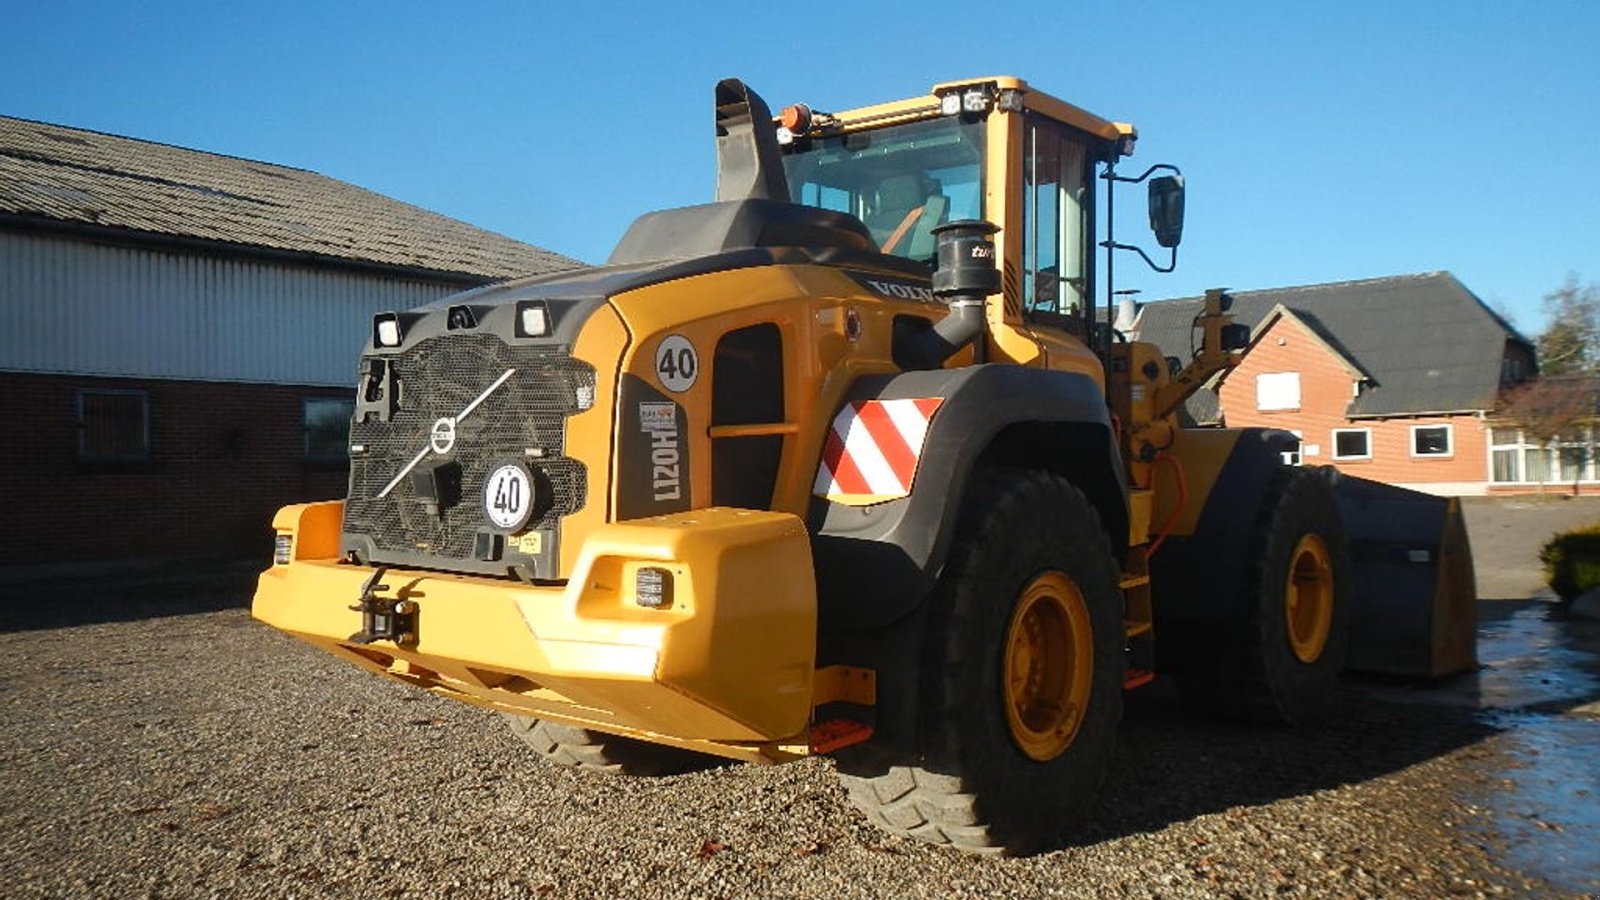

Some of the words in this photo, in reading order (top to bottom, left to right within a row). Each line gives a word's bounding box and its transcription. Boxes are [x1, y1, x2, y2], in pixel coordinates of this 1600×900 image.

[659, 348, 695, 379] 40
[652, 430, 681, 501] L120H
[494, 477, 520, 513] 40
